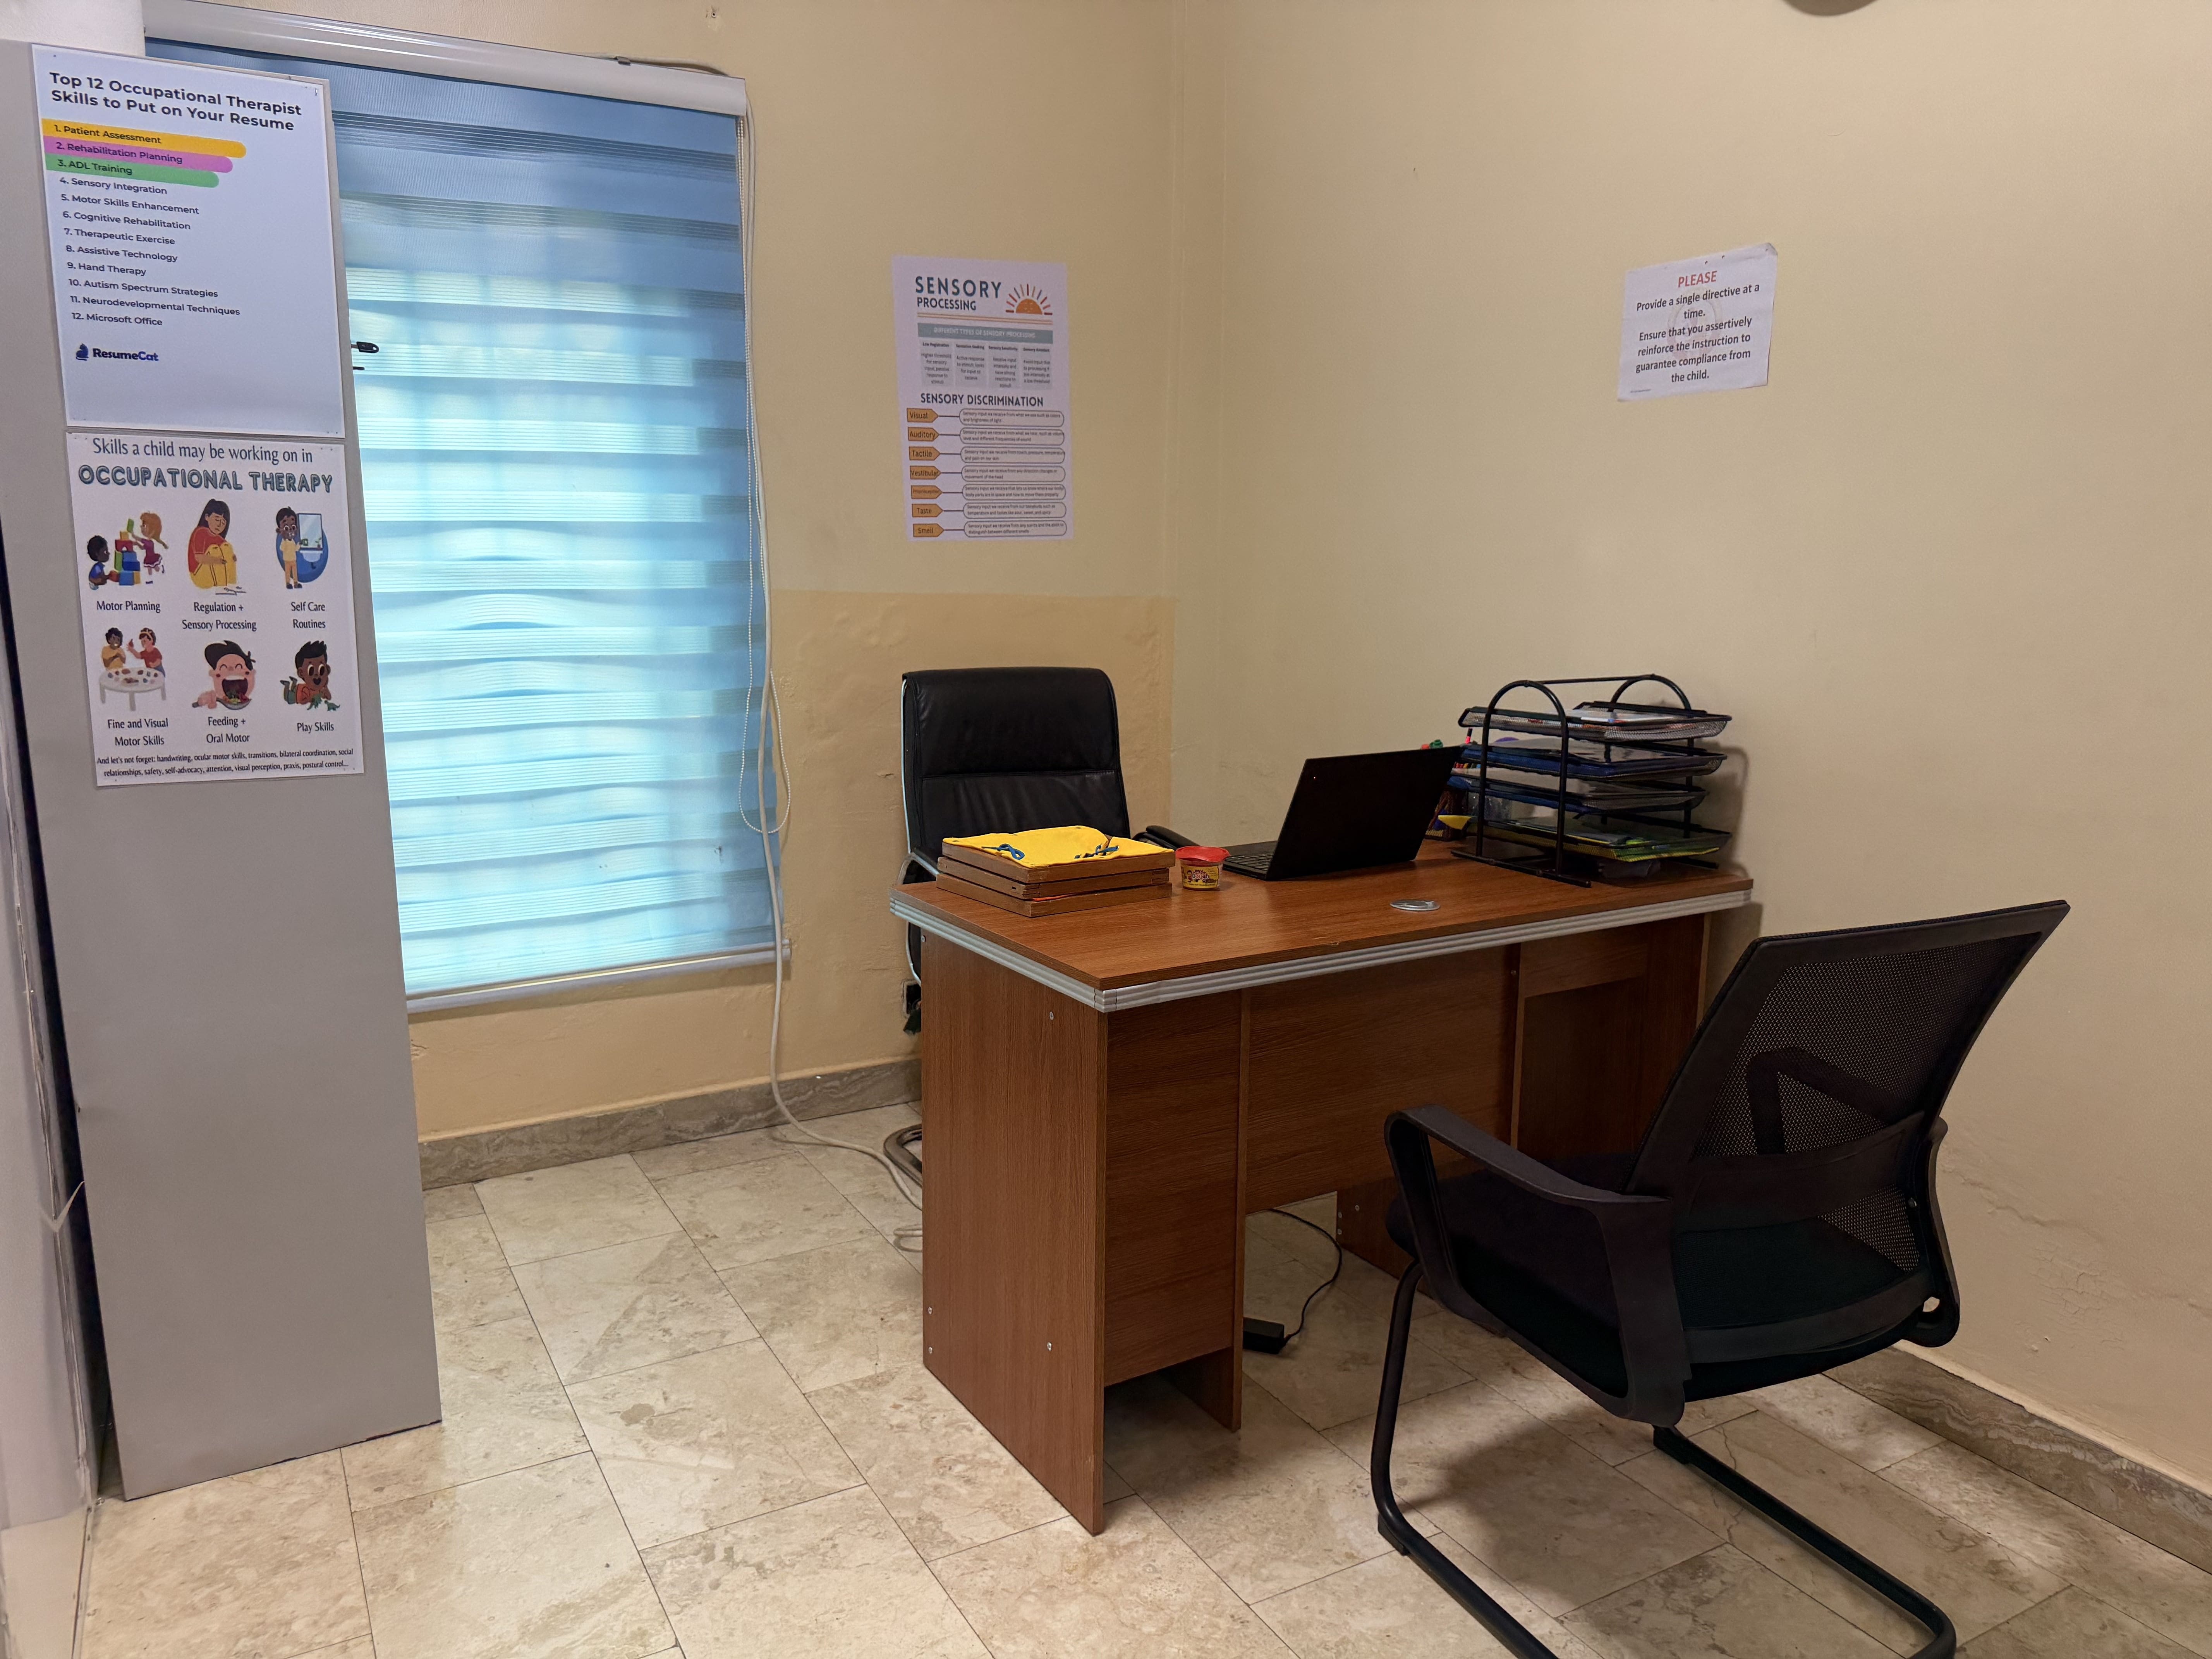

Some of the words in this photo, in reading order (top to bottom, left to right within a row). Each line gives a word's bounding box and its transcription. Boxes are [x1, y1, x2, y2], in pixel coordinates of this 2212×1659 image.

[49, 72, 82, 89] Top
[86, 77, 104, 90] 12
[109, 80, 221, 105] Occupational
[225, 95, 302, 116] Therapist
[52, 89, 98, 106] Skills
[103, 96, 121, 109] to
[127, 99, 156, 113] Put
[161, 106, 182, 117] on
[186, 106, 225, 122] Your
[230, 112, 294, 131] Resume
[54, 124, 62, 132] 1.
[64, 125, 100, 137] Patient
[102, 130, 162, 144] Assessment
[56, 141, 65, 150] 2.
[67, 143, 137, 158] Rehabilitation
[139, 151, 183, 165] Planning
[57, 159, 67, 167] 3.
[68, 160, 91, 170] ADL
[91, 163, 132, 176] Training
[71, 177, 111, 190] Sensory
[113, 182, 167, 195] Integration
[61, 193, 70, 201] 5.
[72, 194, 101, 204] Motor
[103, 198, 129, 208] Skills
[132, 200, 199, 215] Enhancement
[74, 211, 121, 223] Cognitive
[123, 216, 191, 230] Rehabilitation
[64, 227, 73, 235] 7.
[74, 228, 134, 241] Therapeutic
[136, 234, 175, 245] Exercise
[77, 246, 120, 256] Assistive
[121, 249, 178, 263] Technology
[67, 261, 76, 270] 9.
[78, 263, 105, 272] Hand
[106, 264, 146, 277] Therapy
[68, 278, 82, 287] 10.
[83, 280, 119, 289] Autism
[121, 283, 169, 294] Spectrum
[171, 287, 218, 298] Strategies
[915, 275, 1001, 299] SENSORY
[1678, 271, 1717, 288] PLEASE
[70, 295, 81, 303] 11.
[82, 296, 185, 311] Neurodevelopmental
[186, 304, 240, 316] Techniques
[917, 296, 976, 311] PROCESSING
[1637, 298, 1667, 311] Provide
[1669, 298, 1674, 306] a
[1676, 292, 1700, 306] single
[1702, 287, 1741, 301] directive
[1743, 284, 1752, 294] at
[1754, 284, 1760, 292] a
[71, 312, 84, 320] 12.
[86, 313, 132, 324] Microsoft
[134, 317, 163, 326] Office
[1683, 309, 1705, 319] time.
[1639, 330, 1666, 341] Ensure
[1668, 326, 1686, 337] that
[1687, 325, 1703, 337] you
[1705, 316, 1752, 332] assertively
[1638, 344, 1674, 357] reinforce
[1676, 341, 1690, 352] the
[1692, 335, 1739, 349] instruction
[1741, 333, 1751, 343] to
[92, 348, 159, 361] ResumeCat
[1636, 359, 1677, 374] guarantee
[1678, 353, 1727, 367] compliance
[1729, 350, 1751, 360] from
[1671, 372, 1685, 383] the
[1686, 369, 1709, 381] child.
[921, 392, 964, 405] SENSORY
[967, 394, 1043, 407] DISCRIMINATION
[909, 431, 936, 439] Auditory
[93, 437, 129, 455] Skills
[132, 443, 140, 456] a
[144, 440, 175, 457] child
[179, 446, 205, 462] may
[209, 443, 225, 459] be
[228, 445, 279, 466] working
[283, 451, 298, 462] on
[302, 448, 313, 463] in
[78, 464, 243, 491] OCCUPATIONAL
[248, 471, 333, 494] THERAPY
[96, 601, 123, 611] Motor
[125, 600, 161, 614] Planning
[194, 601, 236, 615] Regulation
[290, 601, 306, 612] Self
[307, 601, 325, 612] Care
[182, 619, 213, 632] Sensory
[216, 619, 257, 632] Processing
[293, 618, 326, 629] Routines
[107, 719, 125, 729] Fine
[127, 718, 143, 729] and
[144, 717, 168, 728] Visual
[208, 716, 239, 728] Feeding
[297, 722, 313, 734] Play
[314, 721, 334, 732] Skills
[115, 736, 141, 746] Motor
[143, 735, 165, 746] Skills
[206, 733, 223, 744] Oral
[226, 733, 250, 743] Motor
[110, 756, 123, 764] let's
[136, 755, 156, 765] forget:
[156, 754, 193, 763] handwriting,
[194, 753, 211, 761] ocular
[279, 749, 302, 758] bilateral
[302, 749, 338, 757] coordination,
[338, 748, 354, 756] social
[104, 768, 143, 777] relationships,
[144, 767, 164, 776] safety,
[165, 766, 205, 775] self-advocacy,
[206, 765, 234, 773] attention,
[251, 763, 282, 773] perception,
[283, 762, 301, 771] praxis,
[302, 760, 324, 770] postural
